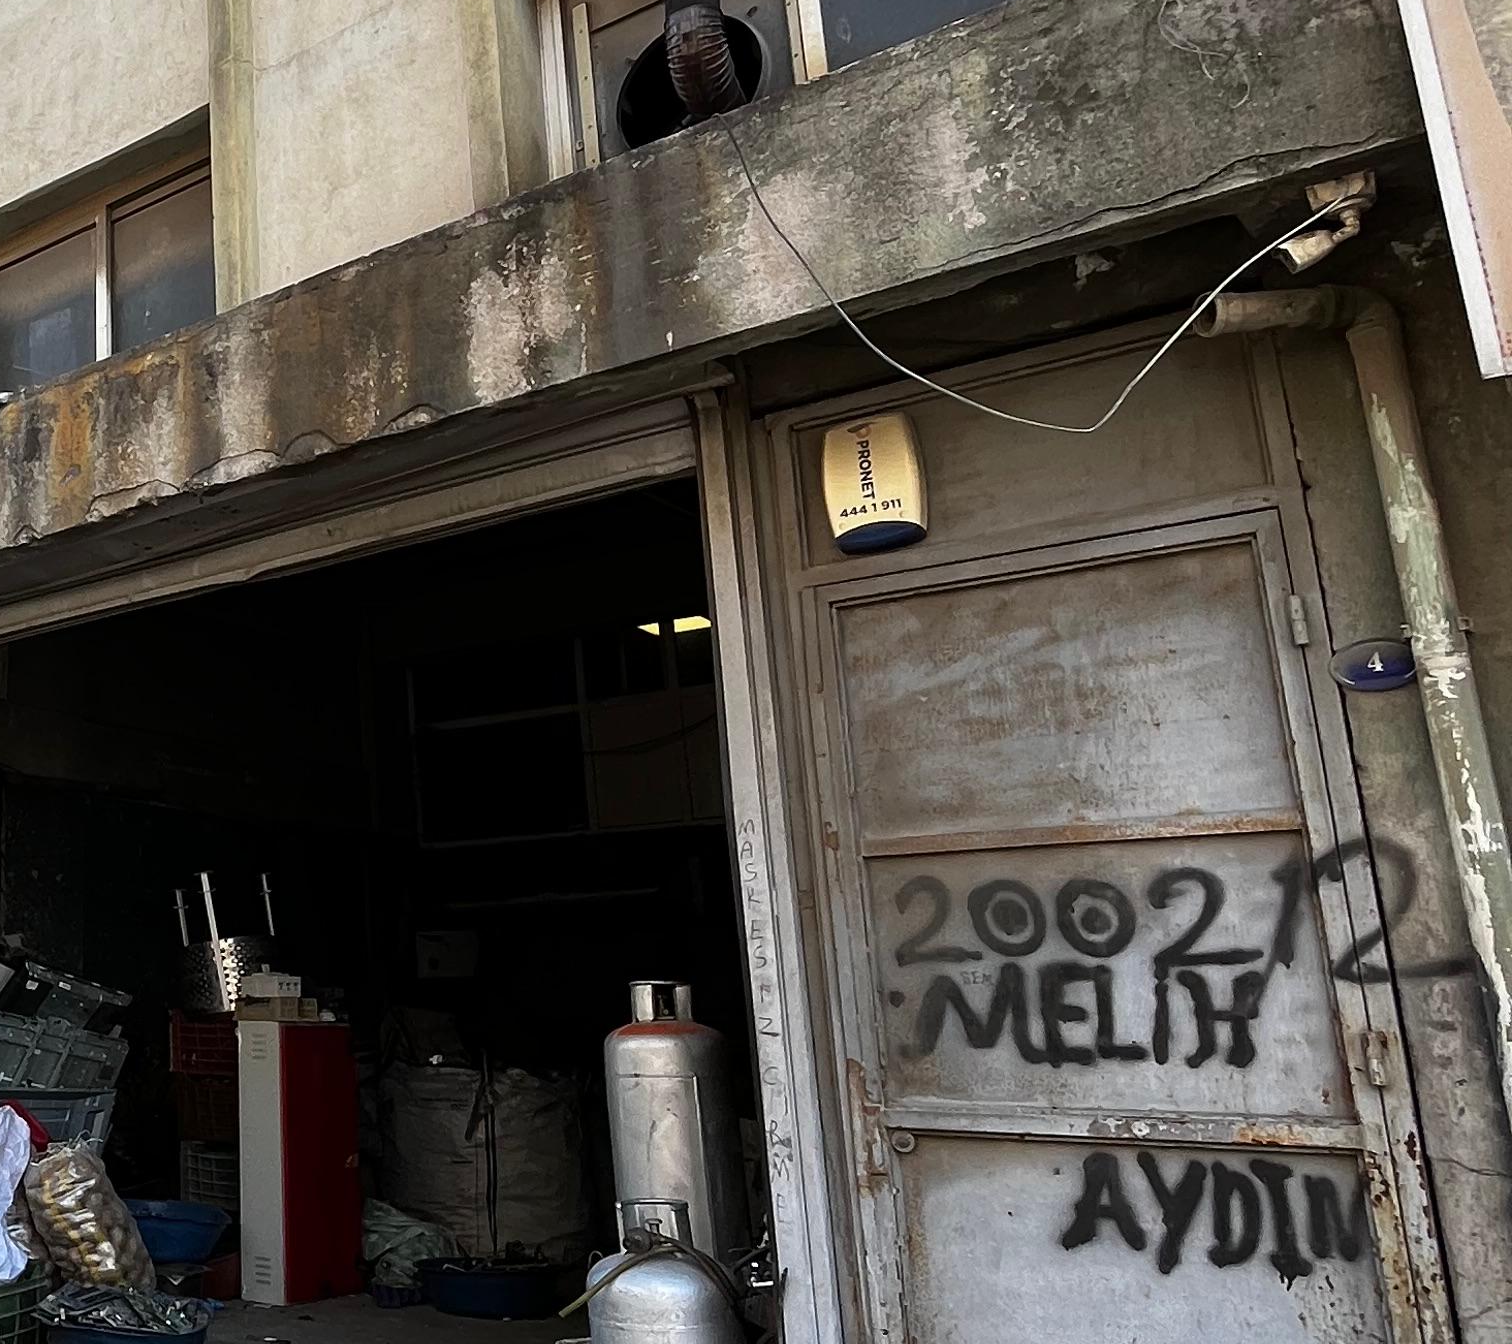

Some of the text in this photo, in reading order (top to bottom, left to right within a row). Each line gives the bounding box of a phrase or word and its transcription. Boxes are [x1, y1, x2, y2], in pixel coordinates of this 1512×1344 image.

[856, 439, 875, 500] PRONET
[839, 498, 902, 518] 444 1 911
[1367, 651, 1384, 673] 4
[1059, 1152, 1368, 1286] AYDIN
